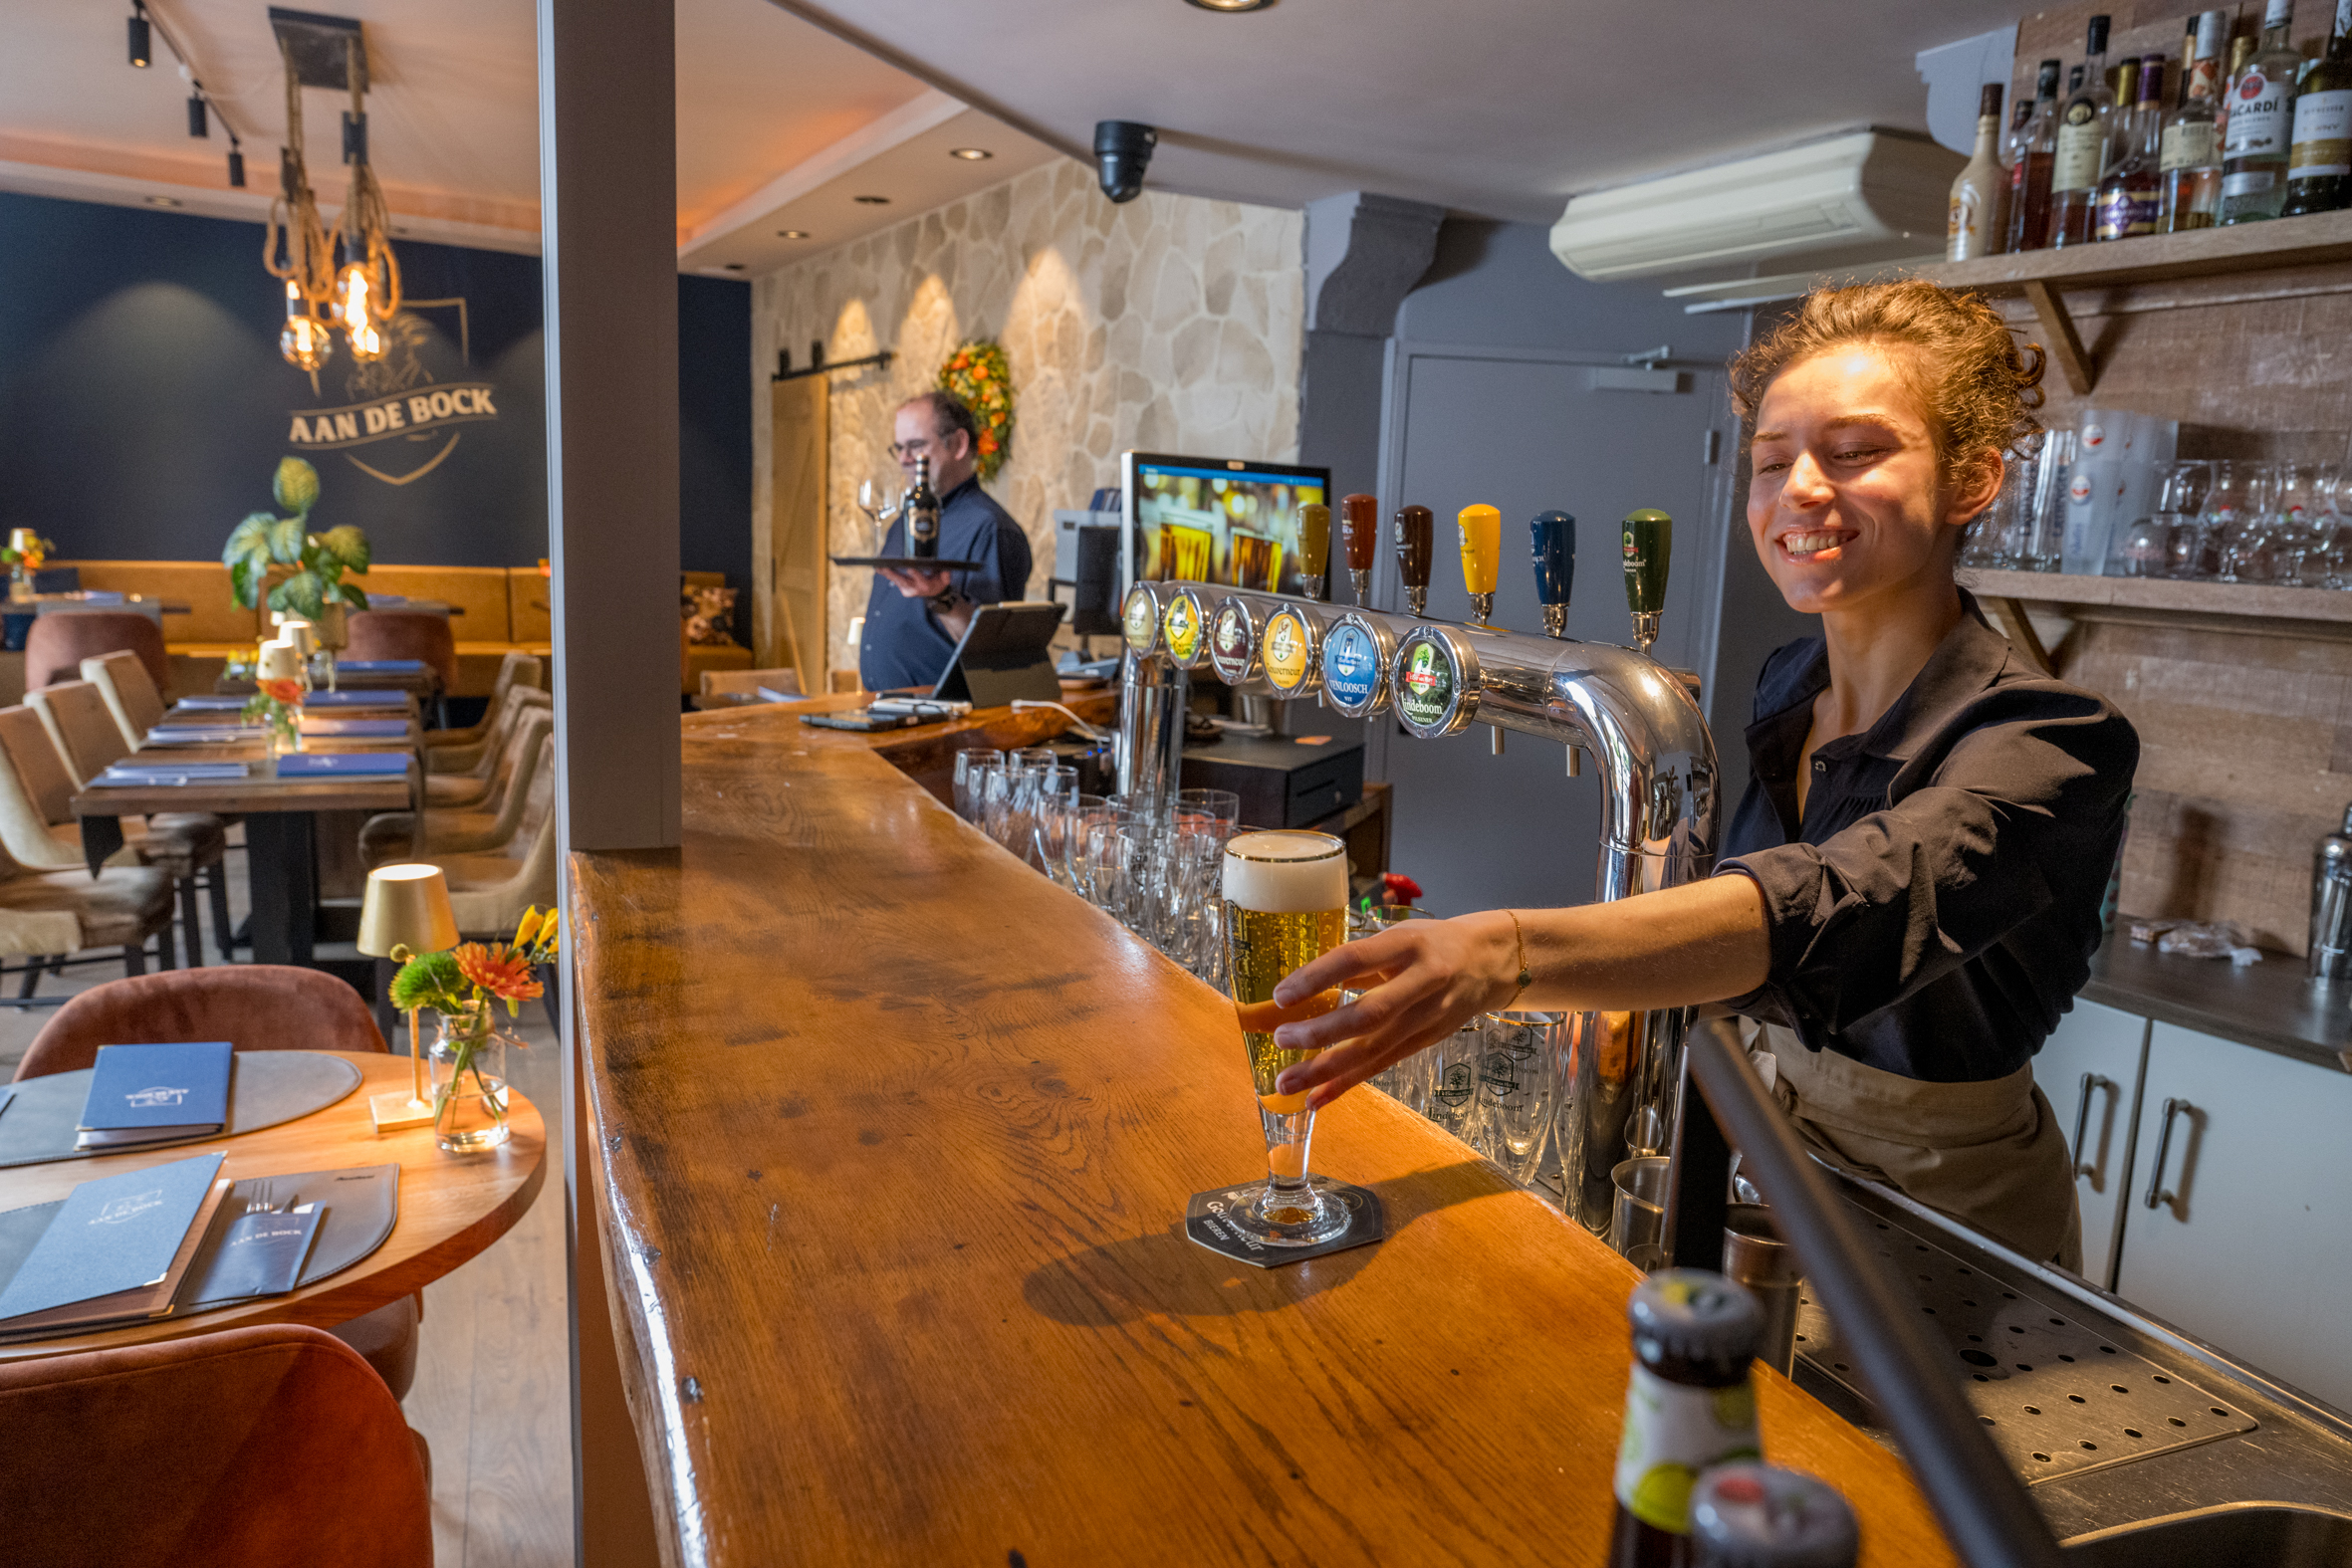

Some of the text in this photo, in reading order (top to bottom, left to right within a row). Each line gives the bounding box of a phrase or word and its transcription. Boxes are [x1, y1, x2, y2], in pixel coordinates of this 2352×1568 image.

[289, 388, 497, 442] AAN DE BOCK
[1329, 679, 1368, 694] VENLOOSCH
[1401, 691, 1443, 715] Lindeboom
[1411, 715, 1433, 724] PILSENER
[1203, 1219, 1230, 1240] BIEREN
